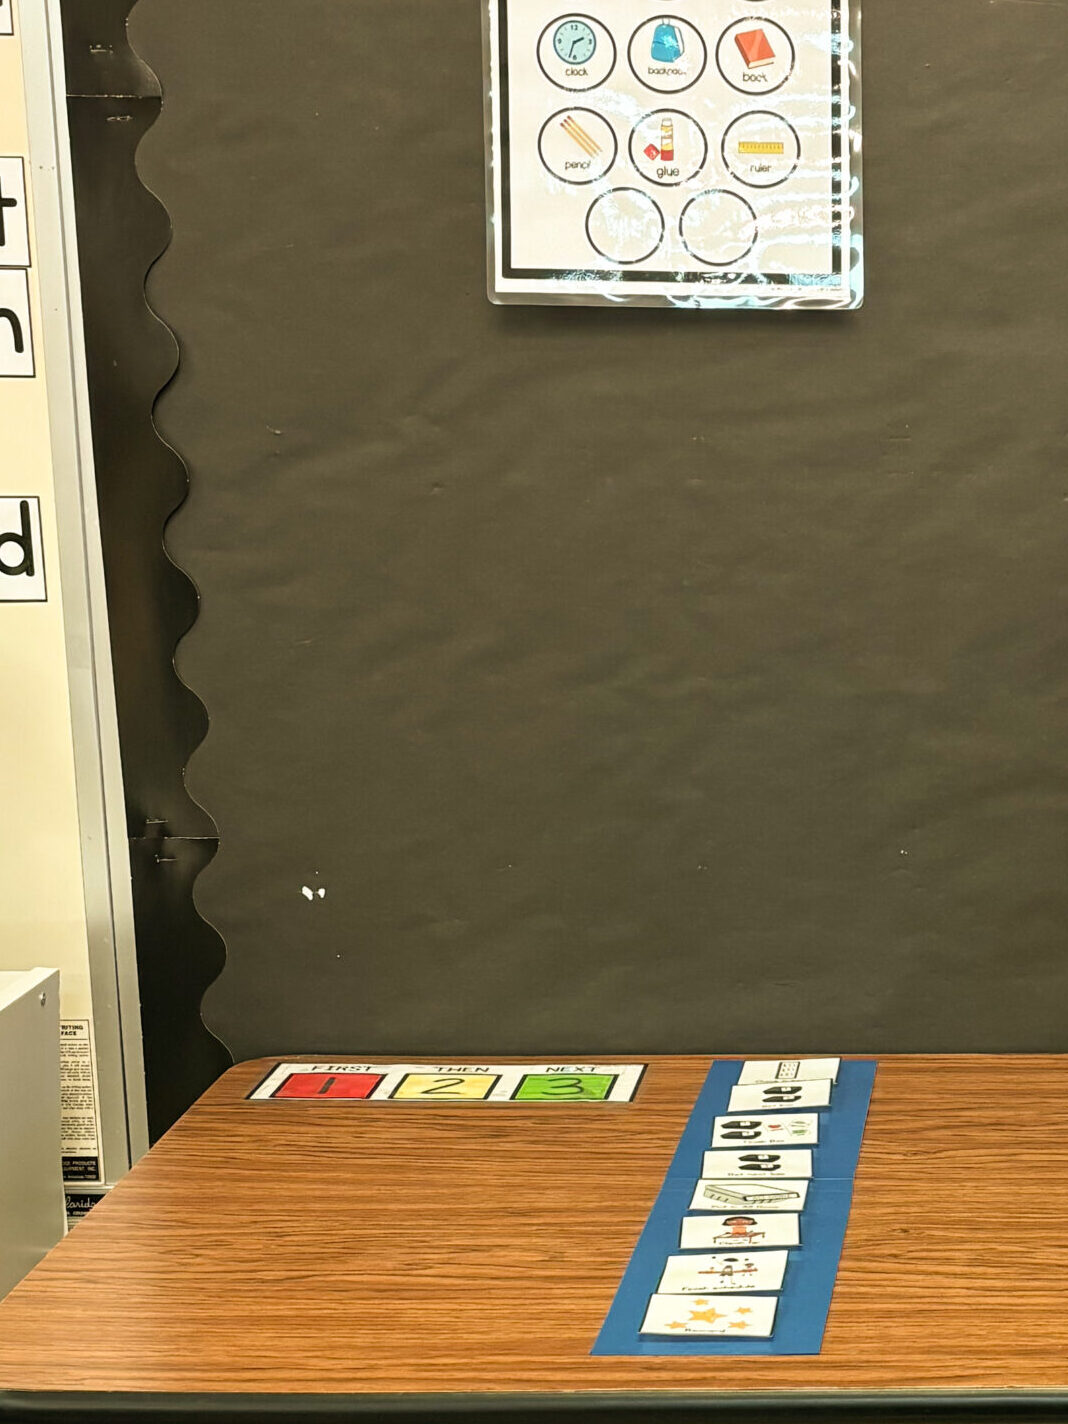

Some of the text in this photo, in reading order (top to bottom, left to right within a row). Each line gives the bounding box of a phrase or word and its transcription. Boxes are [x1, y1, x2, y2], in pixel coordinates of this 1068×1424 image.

[565, 67, 589, 77] clock
[656, 165, 680, 179] glue
[0, 500, 35, 577] d
[318, 1077, 336, 1094] 1
[420, 1077, 466, 1096] 2
[540, 1077, 584, 1096] 3
